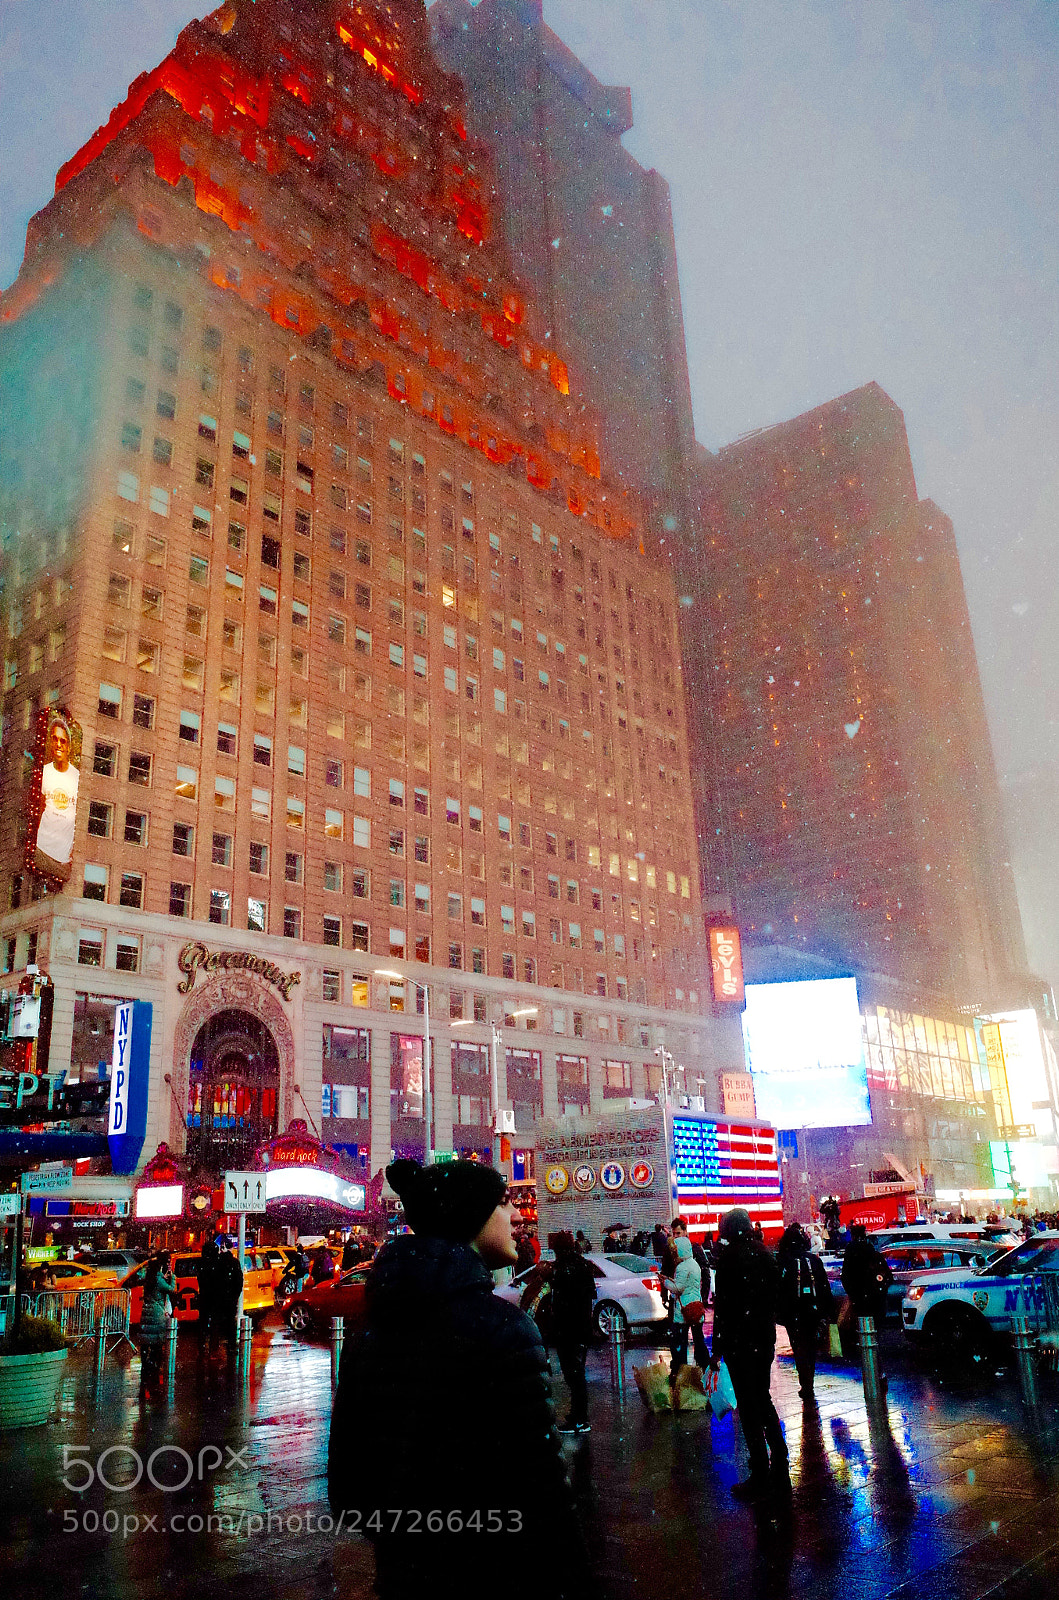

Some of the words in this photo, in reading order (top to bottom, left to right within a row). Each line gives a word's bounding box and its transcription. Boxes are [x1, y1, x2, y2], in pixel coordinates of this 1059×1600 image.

[177, 942, 301, 1002] Paramount
[113, 1007, 130, 1130] NYPD
[724, 1078, 751, 1090] BUBBA
[727, 1091, 751, 1103] GUMP
[608, 1128, 661, 1144] FORCES
[273, 1147, 296, 1161] Hard
[296, 1147, 318, 1163] Rock
[74, 1202, 97, 1215] Hard
[97, 1202, 117, 1216] Rock
[225, 1202, 238, 1210] ONLY
[240, 1202, 251, 1210] ONLY
[253, 1202, 264, 1210] ONLY
[854, 1216, 885, 1226] STRAND
[940, 1282, 964, 1291] POLICE
